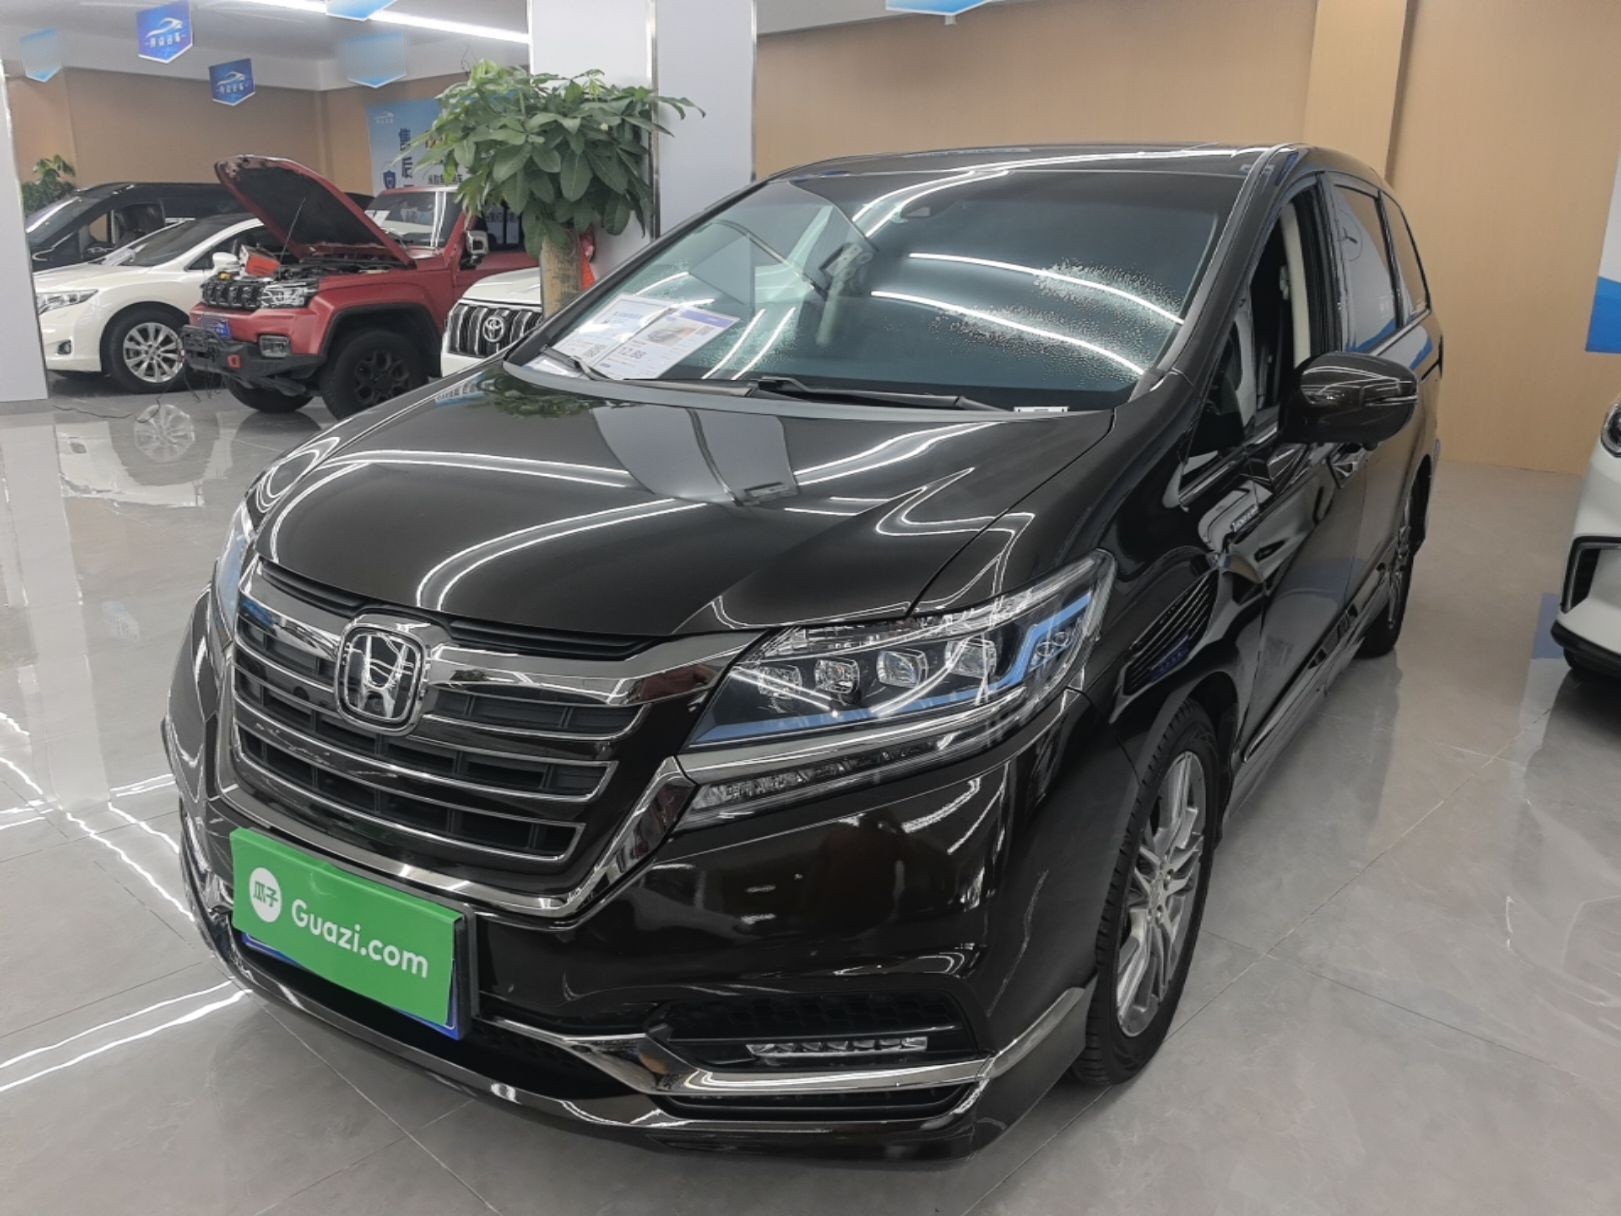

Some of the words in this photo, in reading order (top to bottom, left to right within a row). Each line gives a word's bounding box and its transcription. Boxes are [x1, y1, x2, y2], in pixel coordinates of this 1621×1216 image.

[398, 128, 414, 187] 售后
[253, 880, 279, 908] 瓜子
[291, 899, 429, 979] Guazi.com
